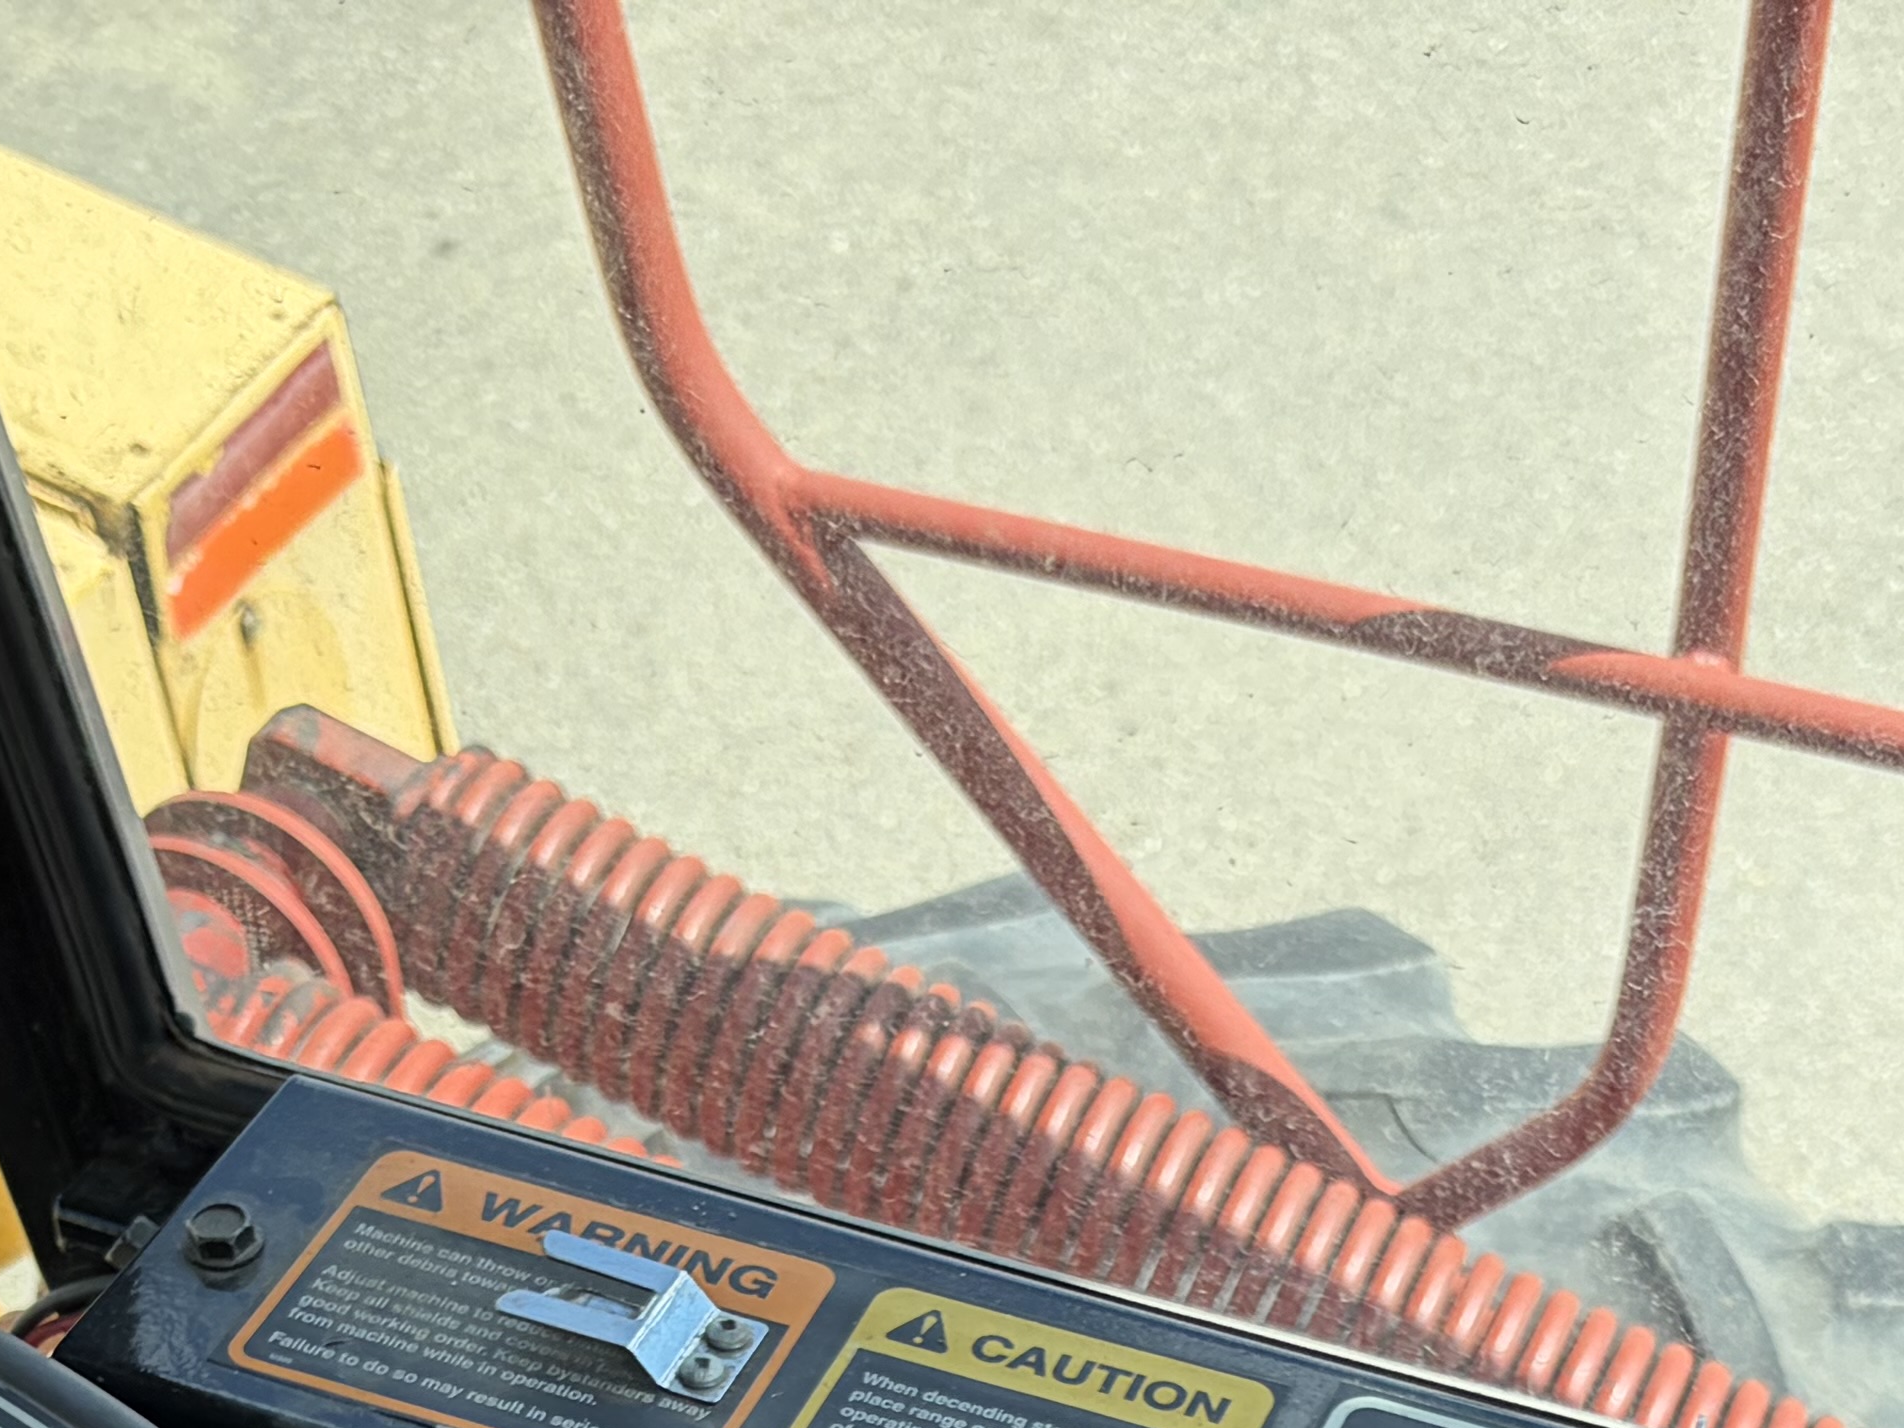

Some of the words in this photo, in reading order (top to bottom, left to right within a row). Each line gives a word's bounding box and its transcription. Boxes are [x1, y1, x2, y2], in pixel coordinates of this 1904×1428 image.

[354, 1222, 434, 1255] Machine
[436, 1248, 473, 1265] can
[476, 1258, 531, 1281] throw
[481, 1191, 779, 1300] WARNING
[268, 1330, 336, 1360] Failure
[338, 1351, 359, 1366] to
[363, 1359, 389, 1375] do
[392, 1369, 418, 1383] so
[420, 1376, 463, 1399] may
[466, 1391, 526, 1416] result
[526, 1405, 547, 1422] in
[288, 1306, 334, 1329] from
[336, 1320, 419, 1353] machine
[423, 1345, 474, 1370] while
[477, 1361, 497, 1376] in
[298, 1294, 350, 1316] good
[354, 1309, 431, 1341] working
[434, 1331, 487, 1356] order.
[493, 1349, 543, 1372] Keep
[546, 1364, 656, 1404] bystanders
[658, 1398, 712, 1421] away
[972, 1333, 1231, 1426] CAUTION
[848, 1390, 905, 1412] place
[862, 1371, 919, 1397] When
